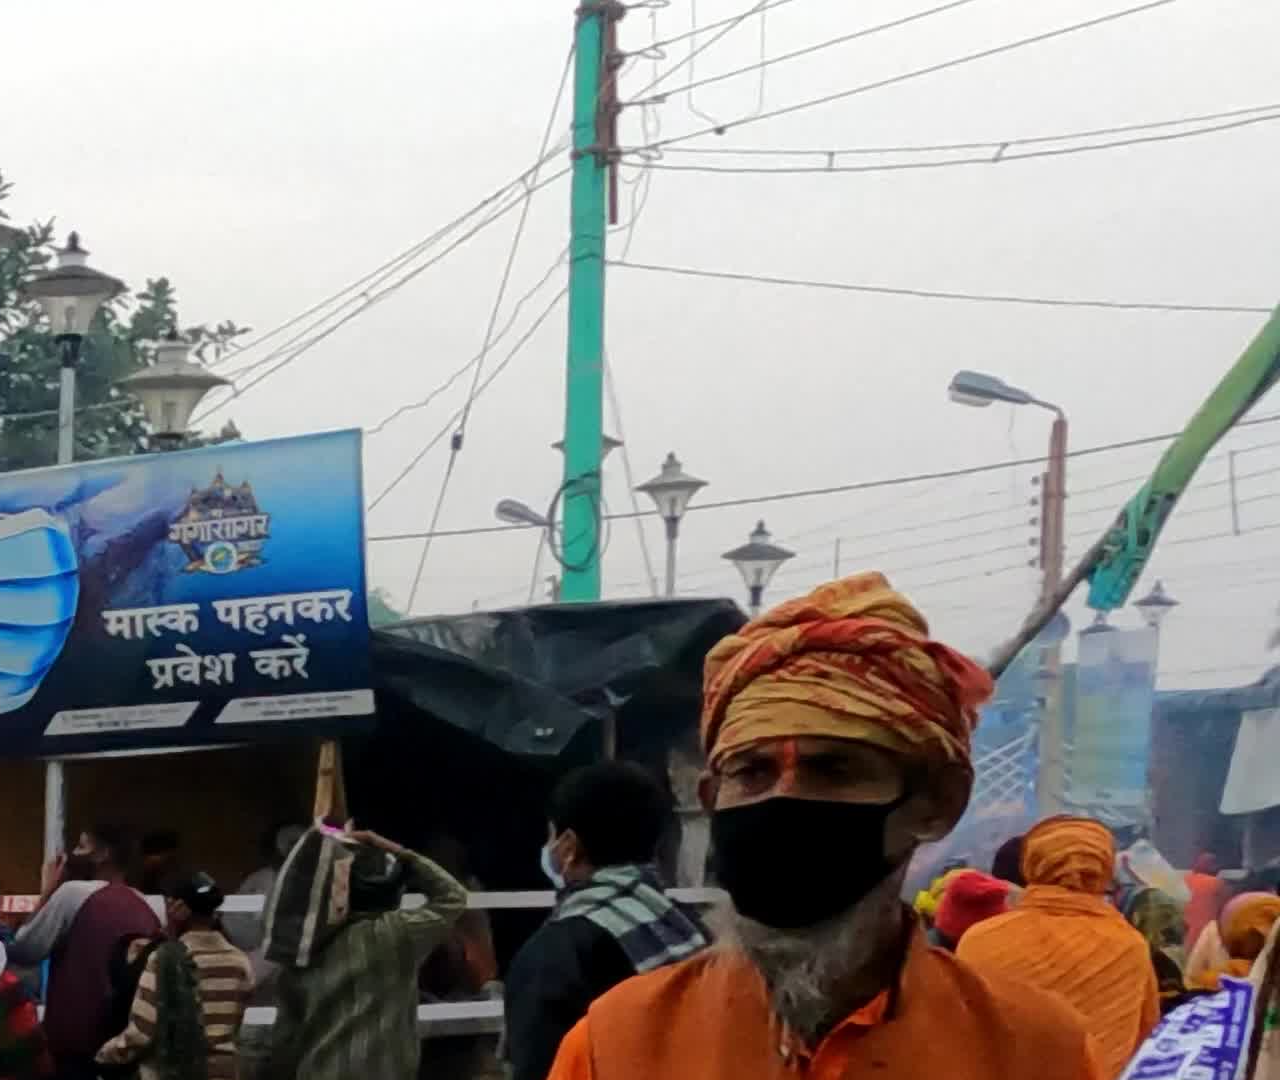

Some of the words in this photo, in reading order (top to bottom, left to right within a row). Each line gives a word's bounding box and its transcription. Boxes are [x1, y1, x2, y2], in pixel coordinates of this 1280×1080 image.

[101, 603, 200, 640] मास्क
[212, 589, 353, 635] पहनकर
[145, 643, 236, 690] प्रवेश
[249, 633, 310, 679] करें
